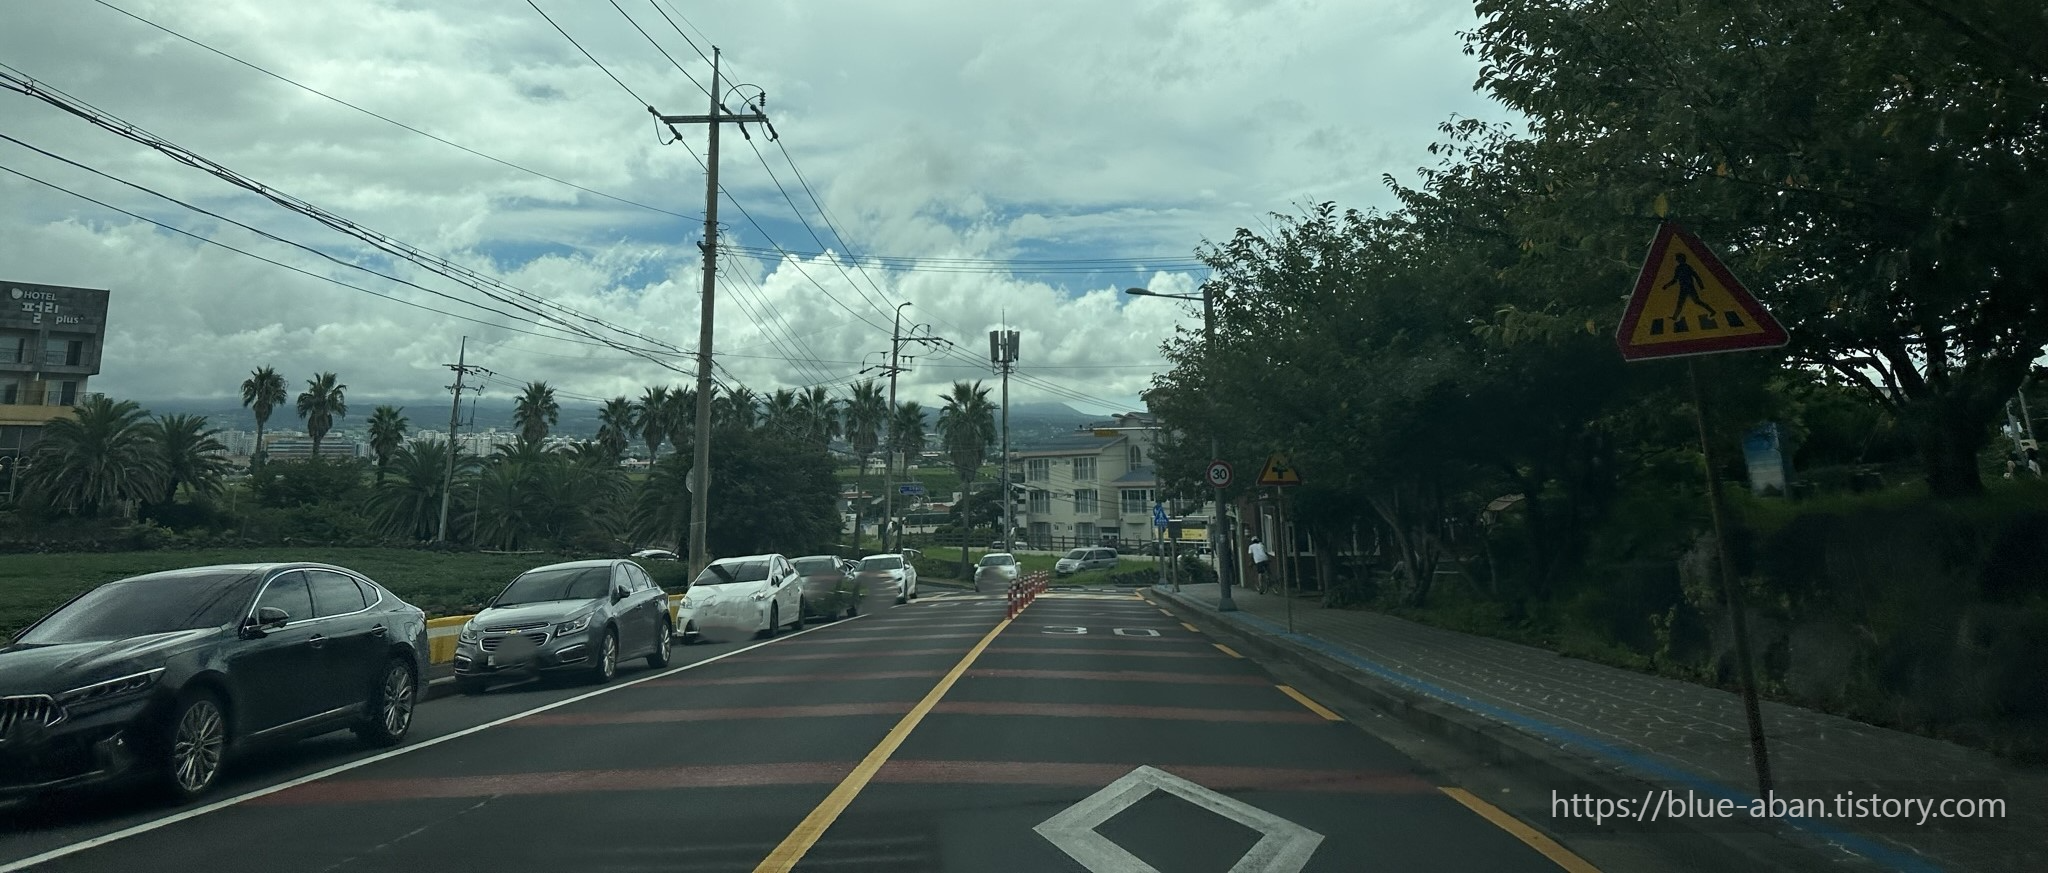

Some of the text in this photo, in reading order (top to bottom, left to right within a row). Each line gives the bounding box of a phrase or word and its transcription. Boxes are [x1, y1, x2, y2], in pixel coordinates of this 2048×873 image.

[23, 290, 57, 301] HOTEL
[21, 301, 59, 324] 펄리
[1212, 468, 1227, 480] 30
